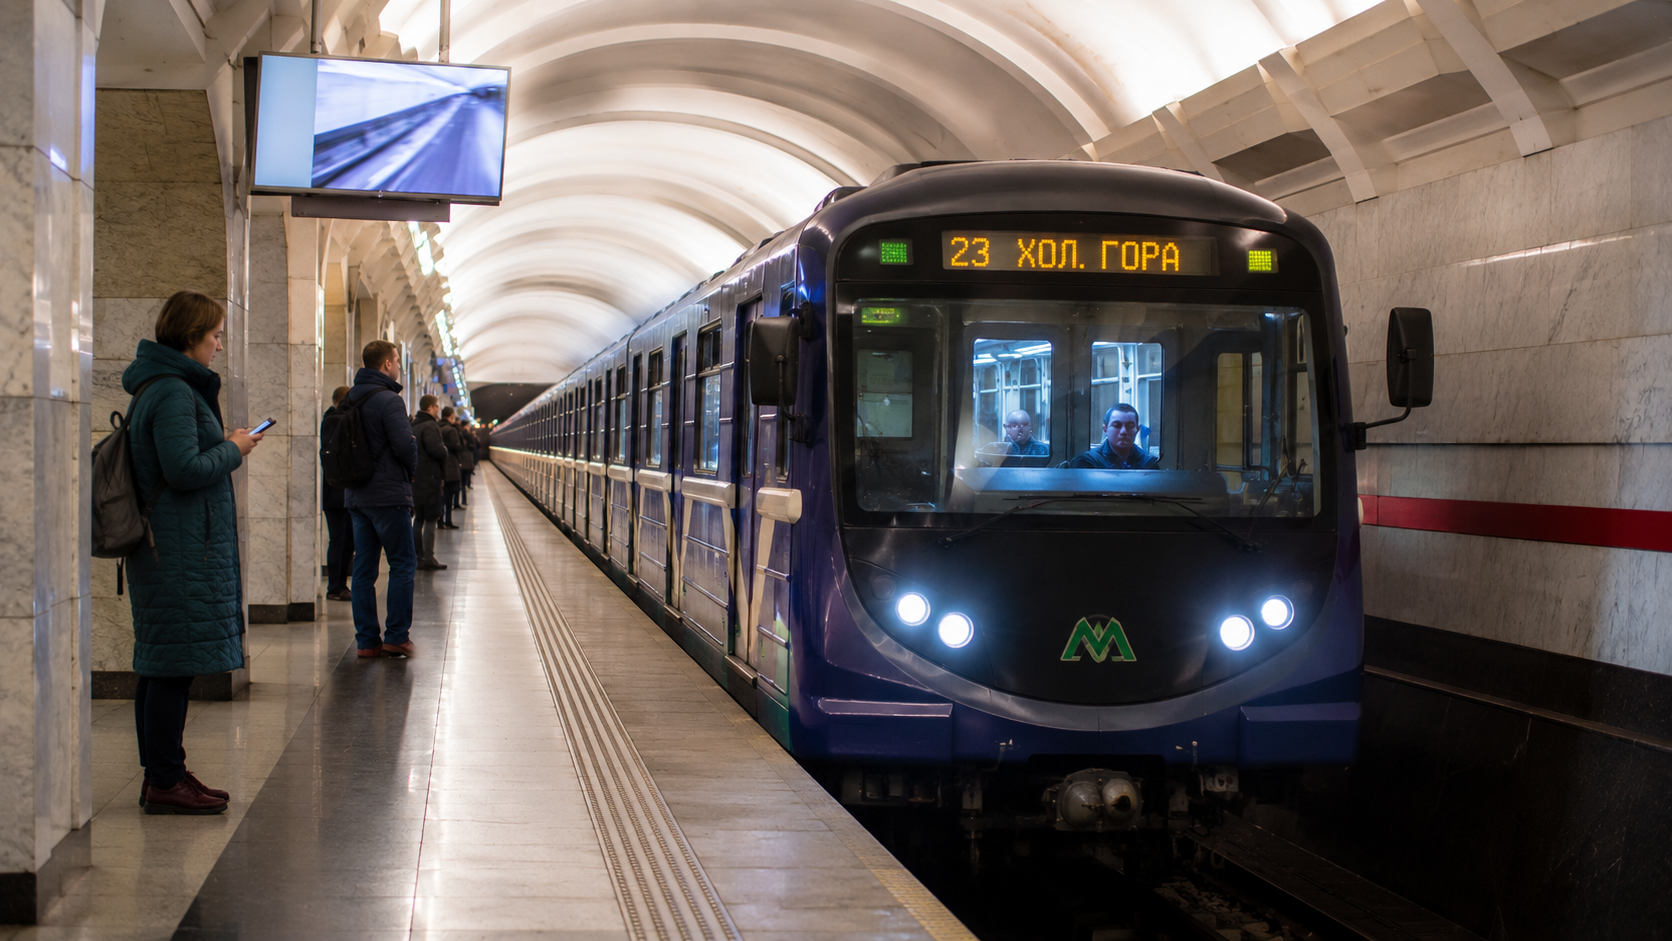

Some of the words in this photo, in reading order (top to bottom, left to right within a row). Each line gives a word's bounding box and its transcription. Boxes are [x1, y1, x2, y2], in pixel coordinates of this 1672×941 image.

[951, 237, 989, 267] 23
[1017, 238, 1085, 269] ХОЛ.
[1101, 240, 1180, 272] ГОРА
